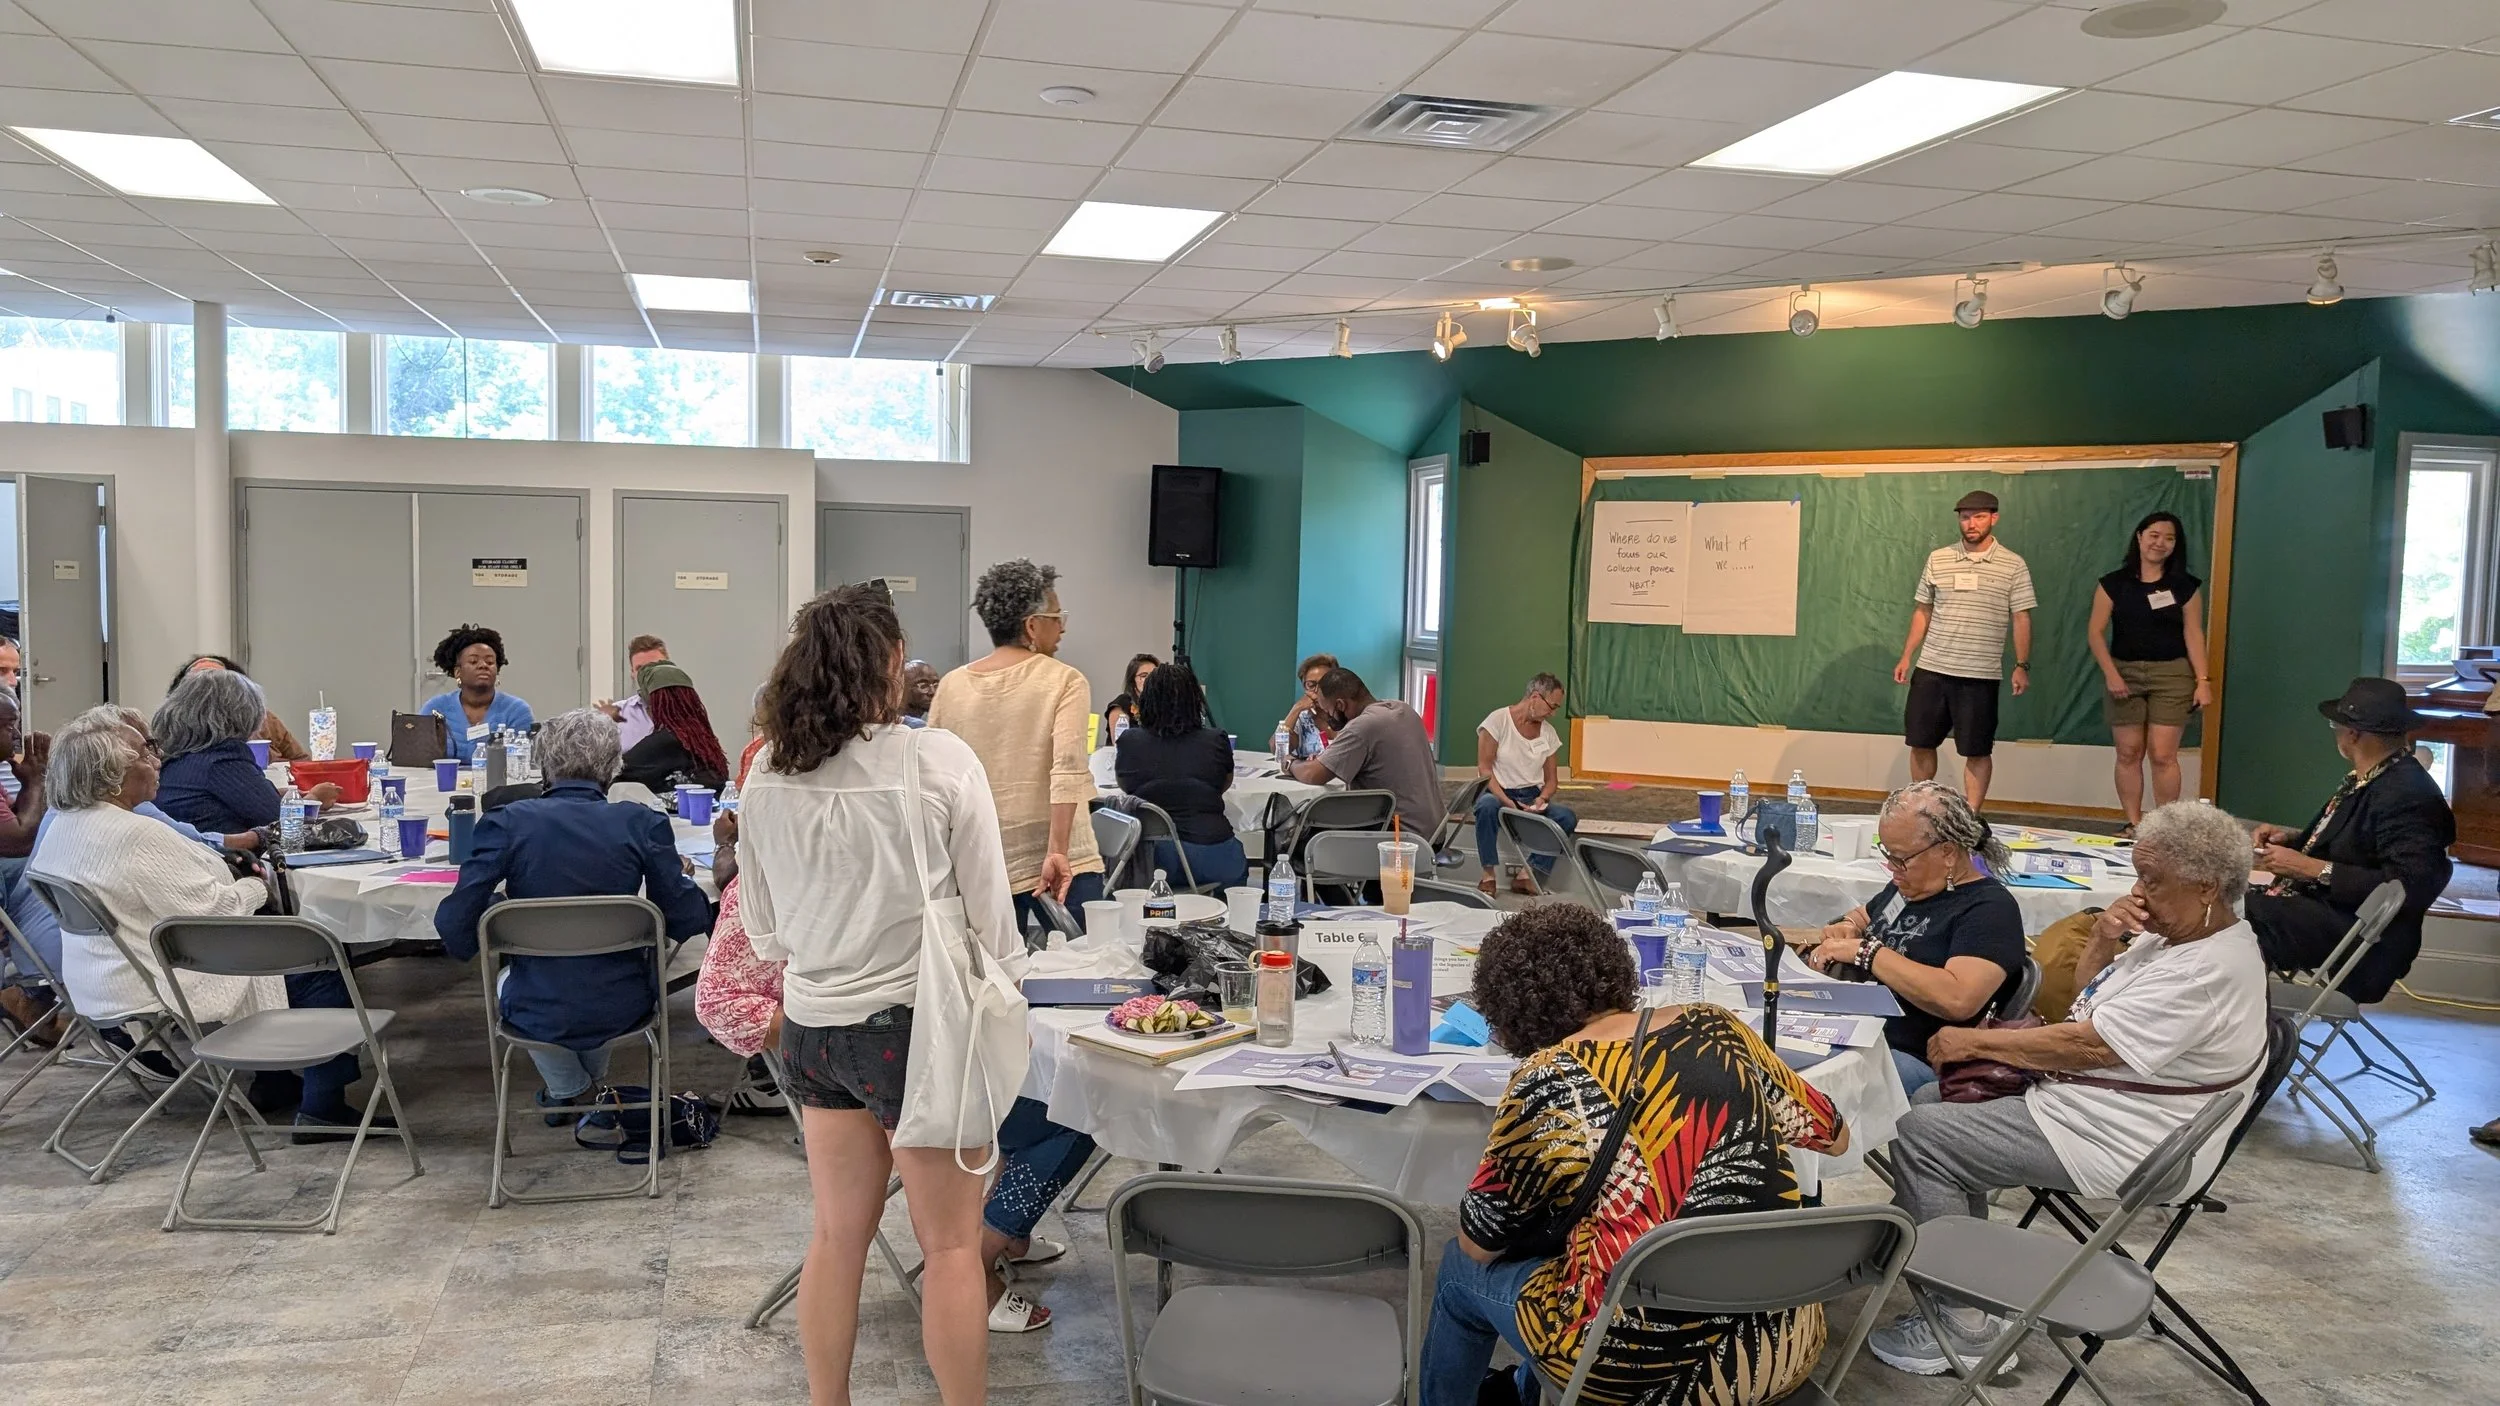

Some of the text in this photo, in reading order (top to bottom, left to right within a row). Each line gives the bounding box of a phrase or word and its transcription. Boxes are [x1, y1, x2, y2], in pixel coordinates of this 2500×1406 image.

[1646, 533, 1660, 544] do
[1704, 535, 1753, 552] What if
[1617, 547, 1640, 559] focus
[1149, 909, 1174, 917] PRIDE
[1315, 932, 1355, 944] Table
